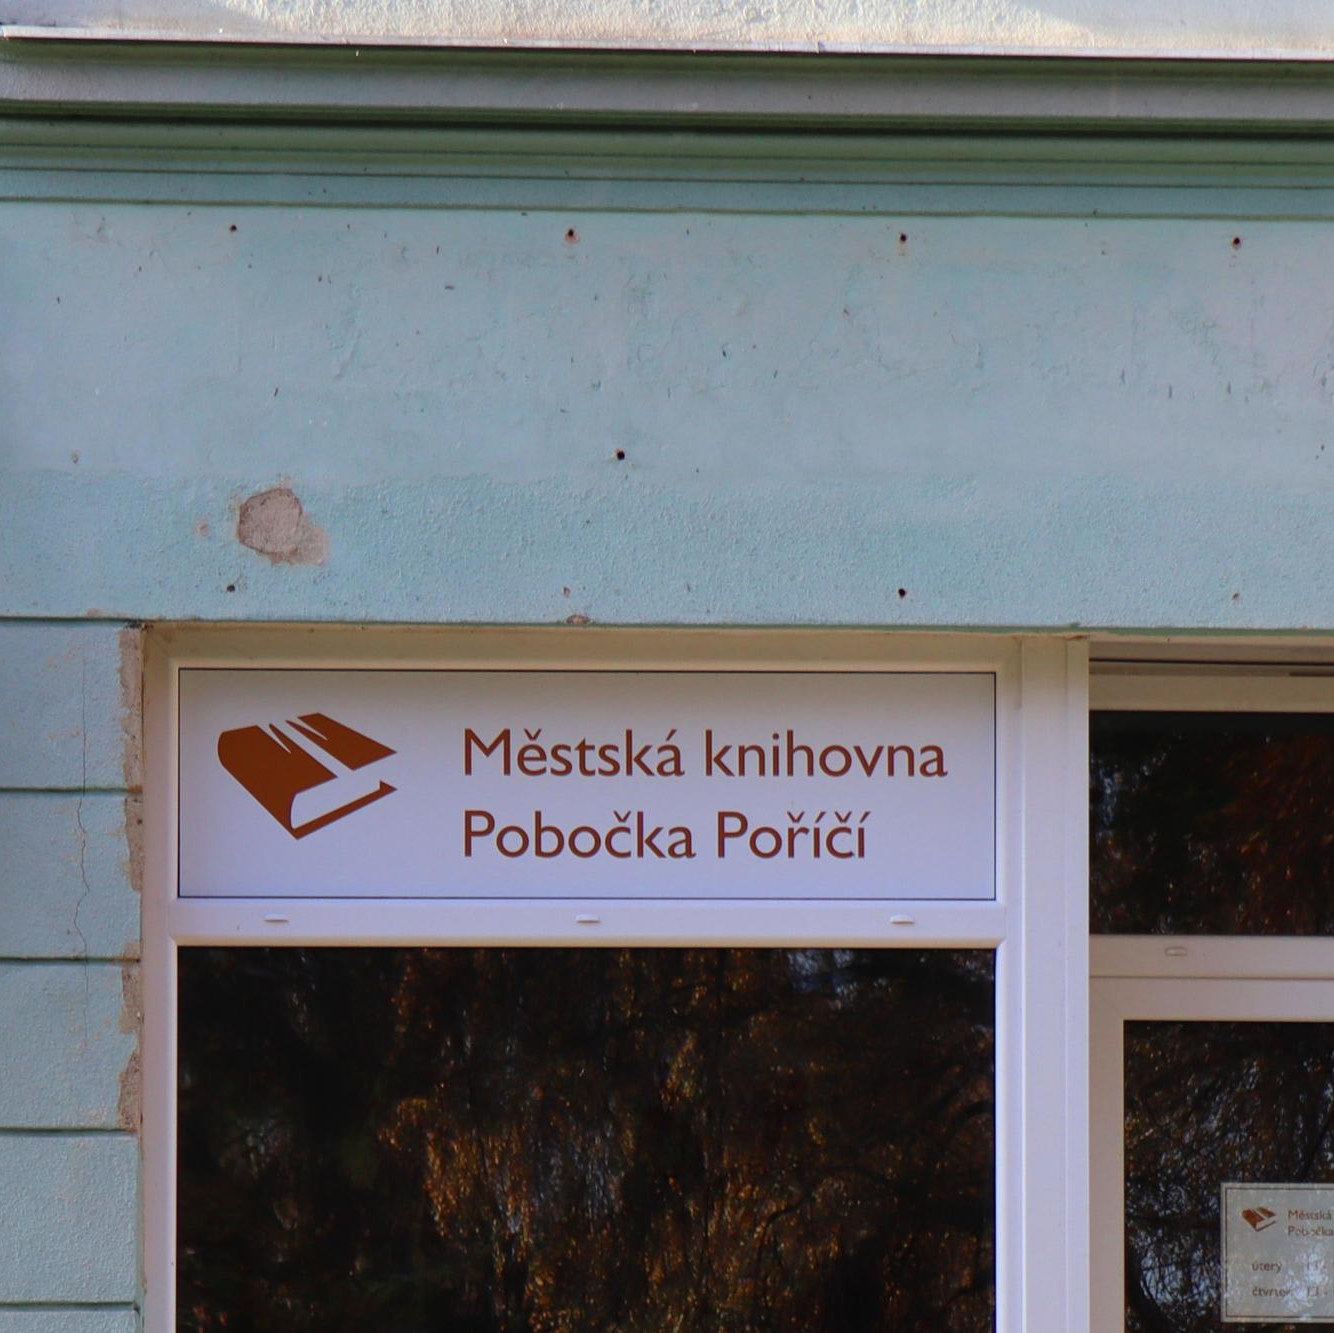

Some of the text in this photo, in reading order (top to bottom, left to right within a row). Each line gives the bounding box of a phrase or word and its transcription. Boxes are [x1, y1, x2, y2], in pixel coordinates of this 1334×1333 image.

[464, 728, 949, 779] Městská knihovna
[464, 809, 872, 860] Pobočka Poříčí
[1287, 1208, 1332, 1221] Městská
